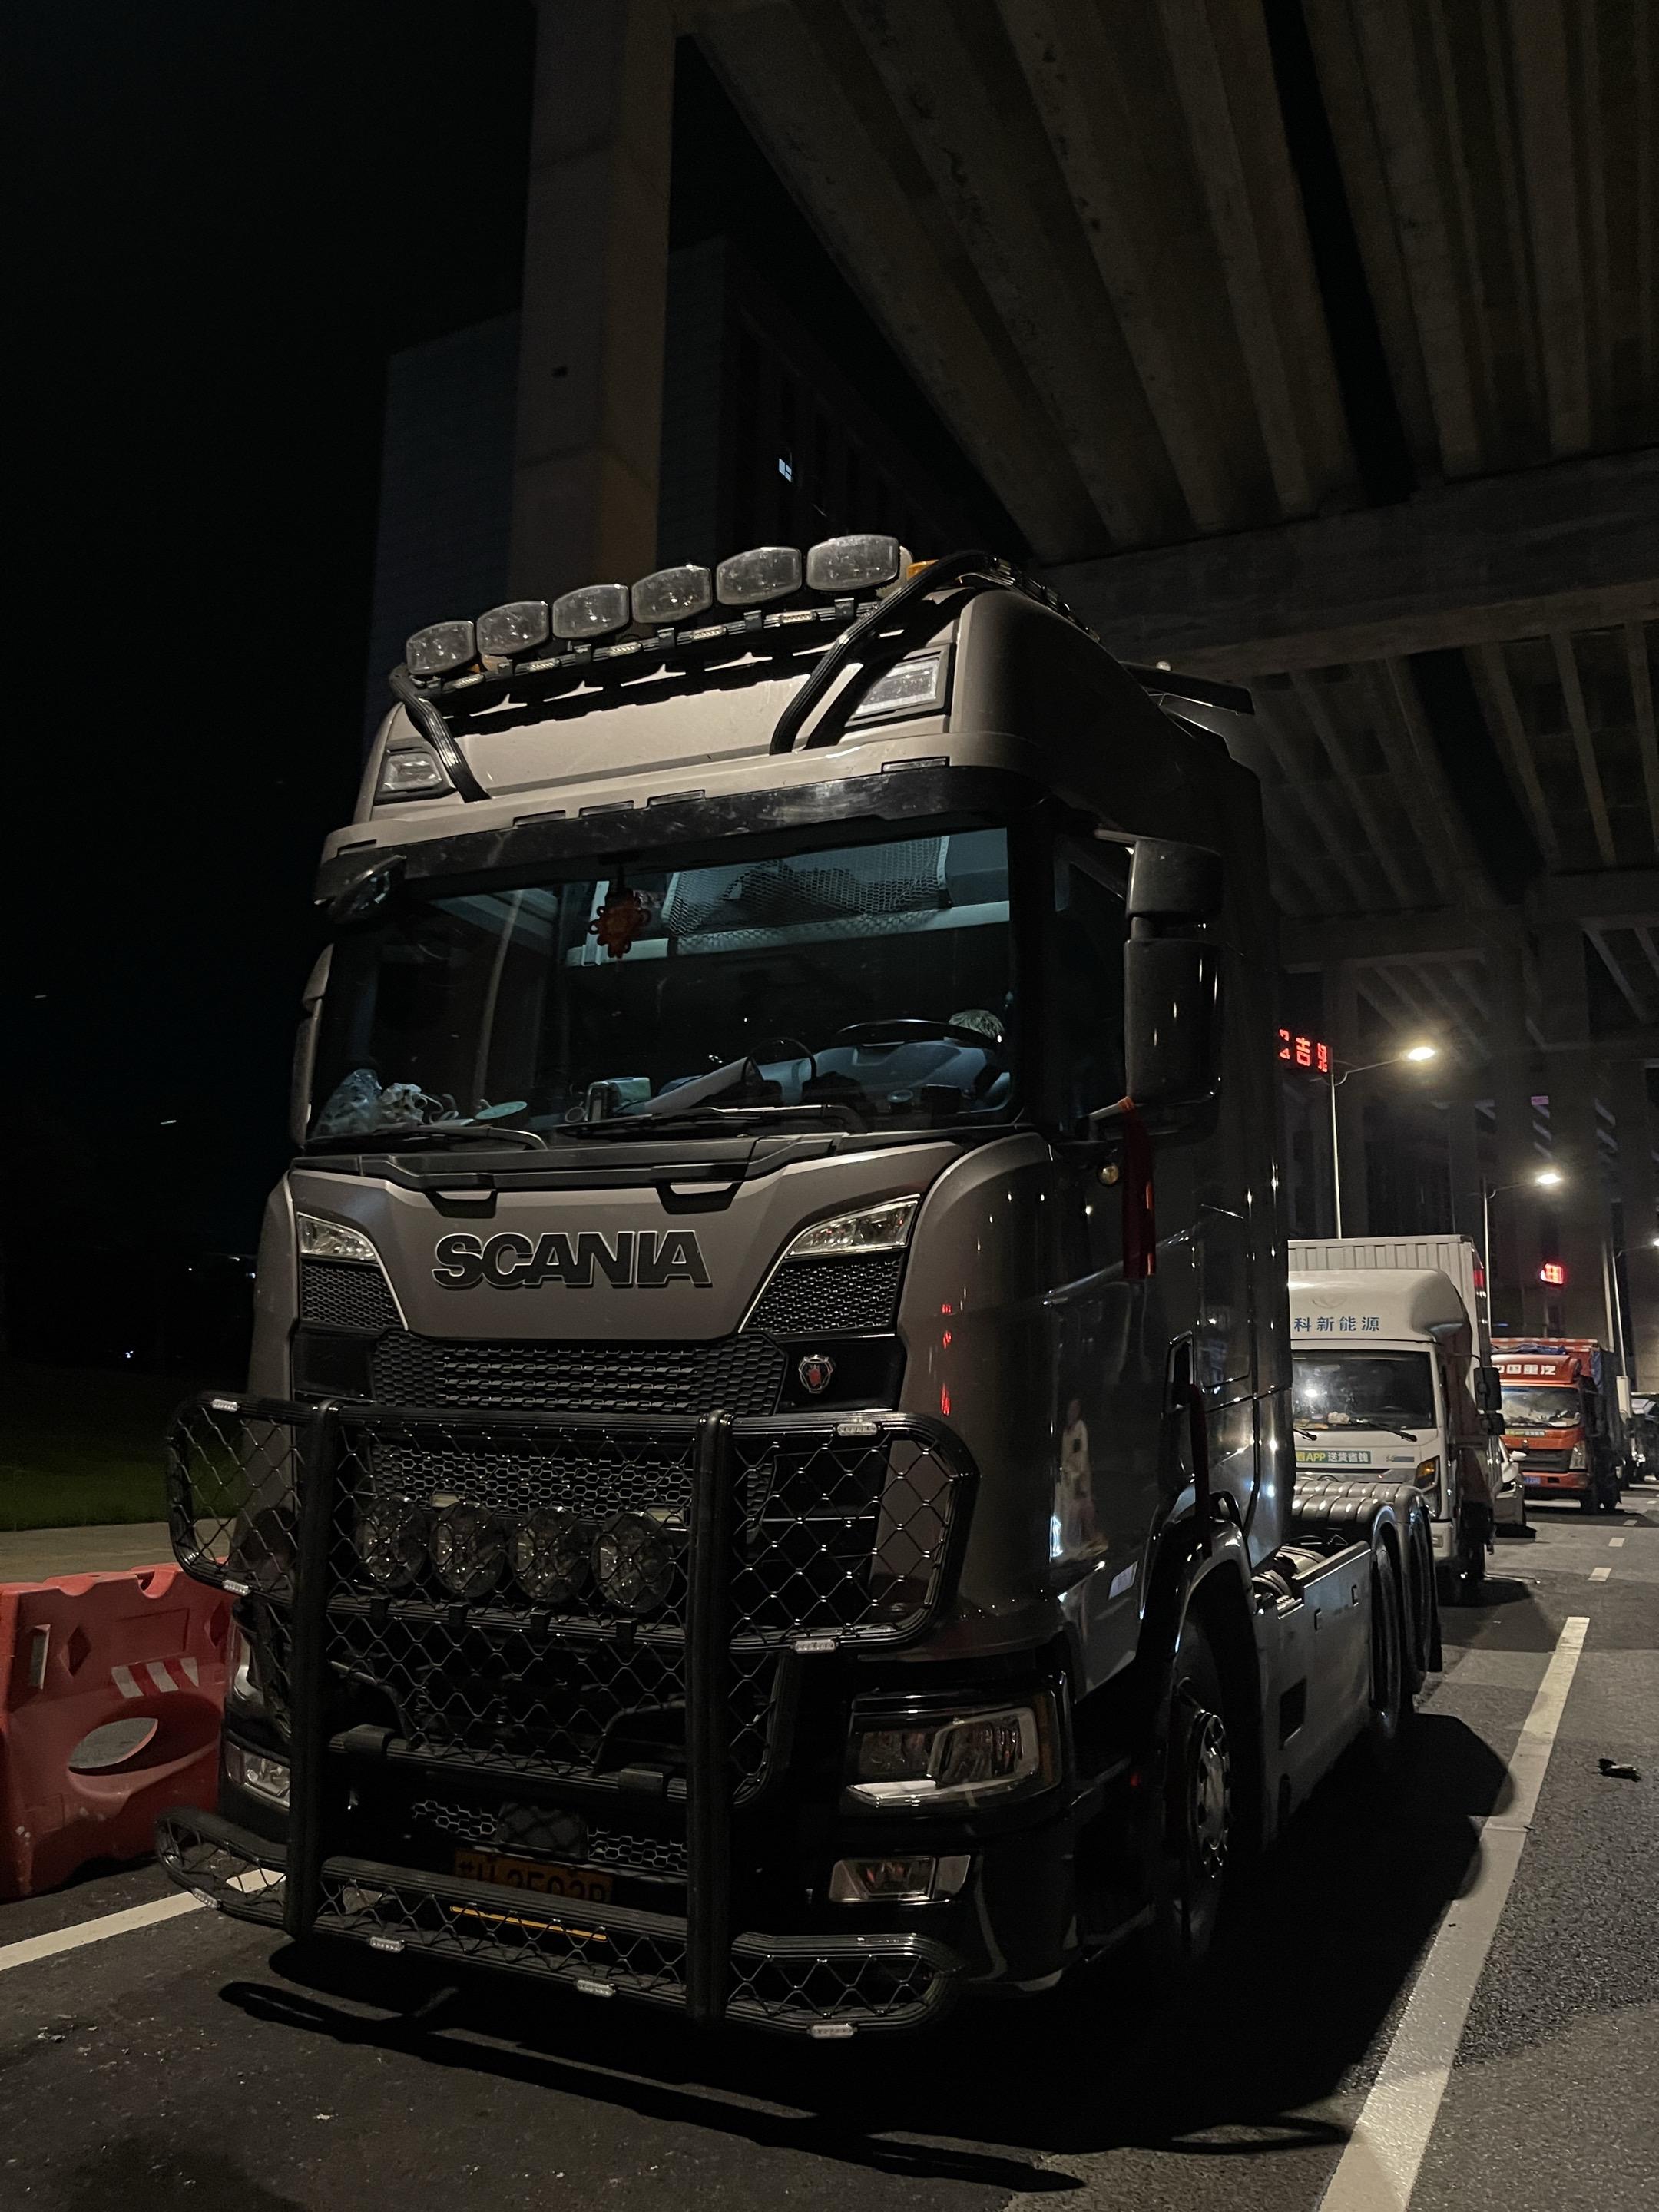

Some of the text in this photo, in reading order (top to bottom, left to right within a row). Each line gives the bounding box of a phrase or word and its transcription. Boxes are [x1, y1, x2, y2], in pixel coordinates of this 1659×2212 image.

[432, 1230, 712, 1288] SCANIA
[1293, 1316, 1380, 1332] 科新能源
